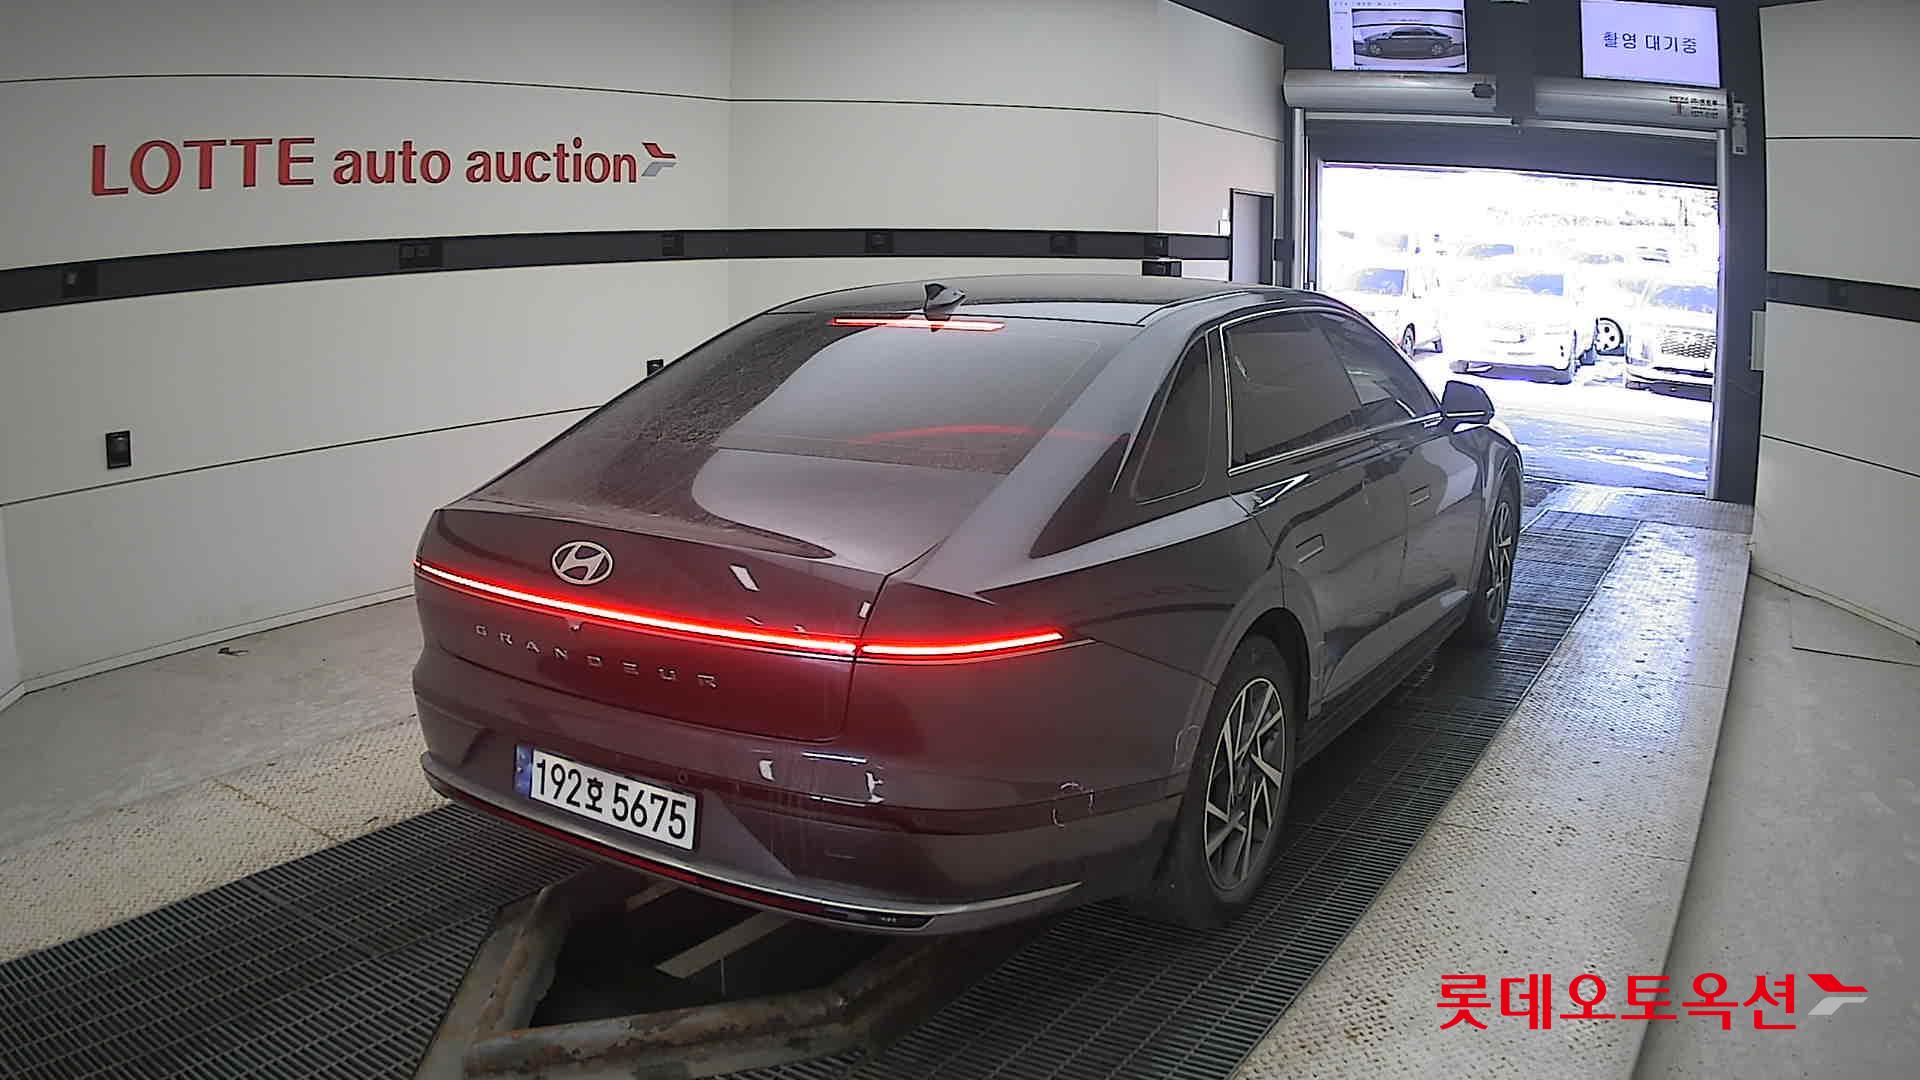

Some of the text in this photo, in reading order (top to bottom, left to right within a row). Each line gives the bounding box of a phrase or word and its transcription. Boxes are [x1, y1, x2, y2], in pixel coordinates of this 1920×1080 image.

[1645, 34, 1697, 54] 대기중
[91, 136, 638, 197] LOTTE auto auction
[475, 624, 719, 689] GRANDEUR
